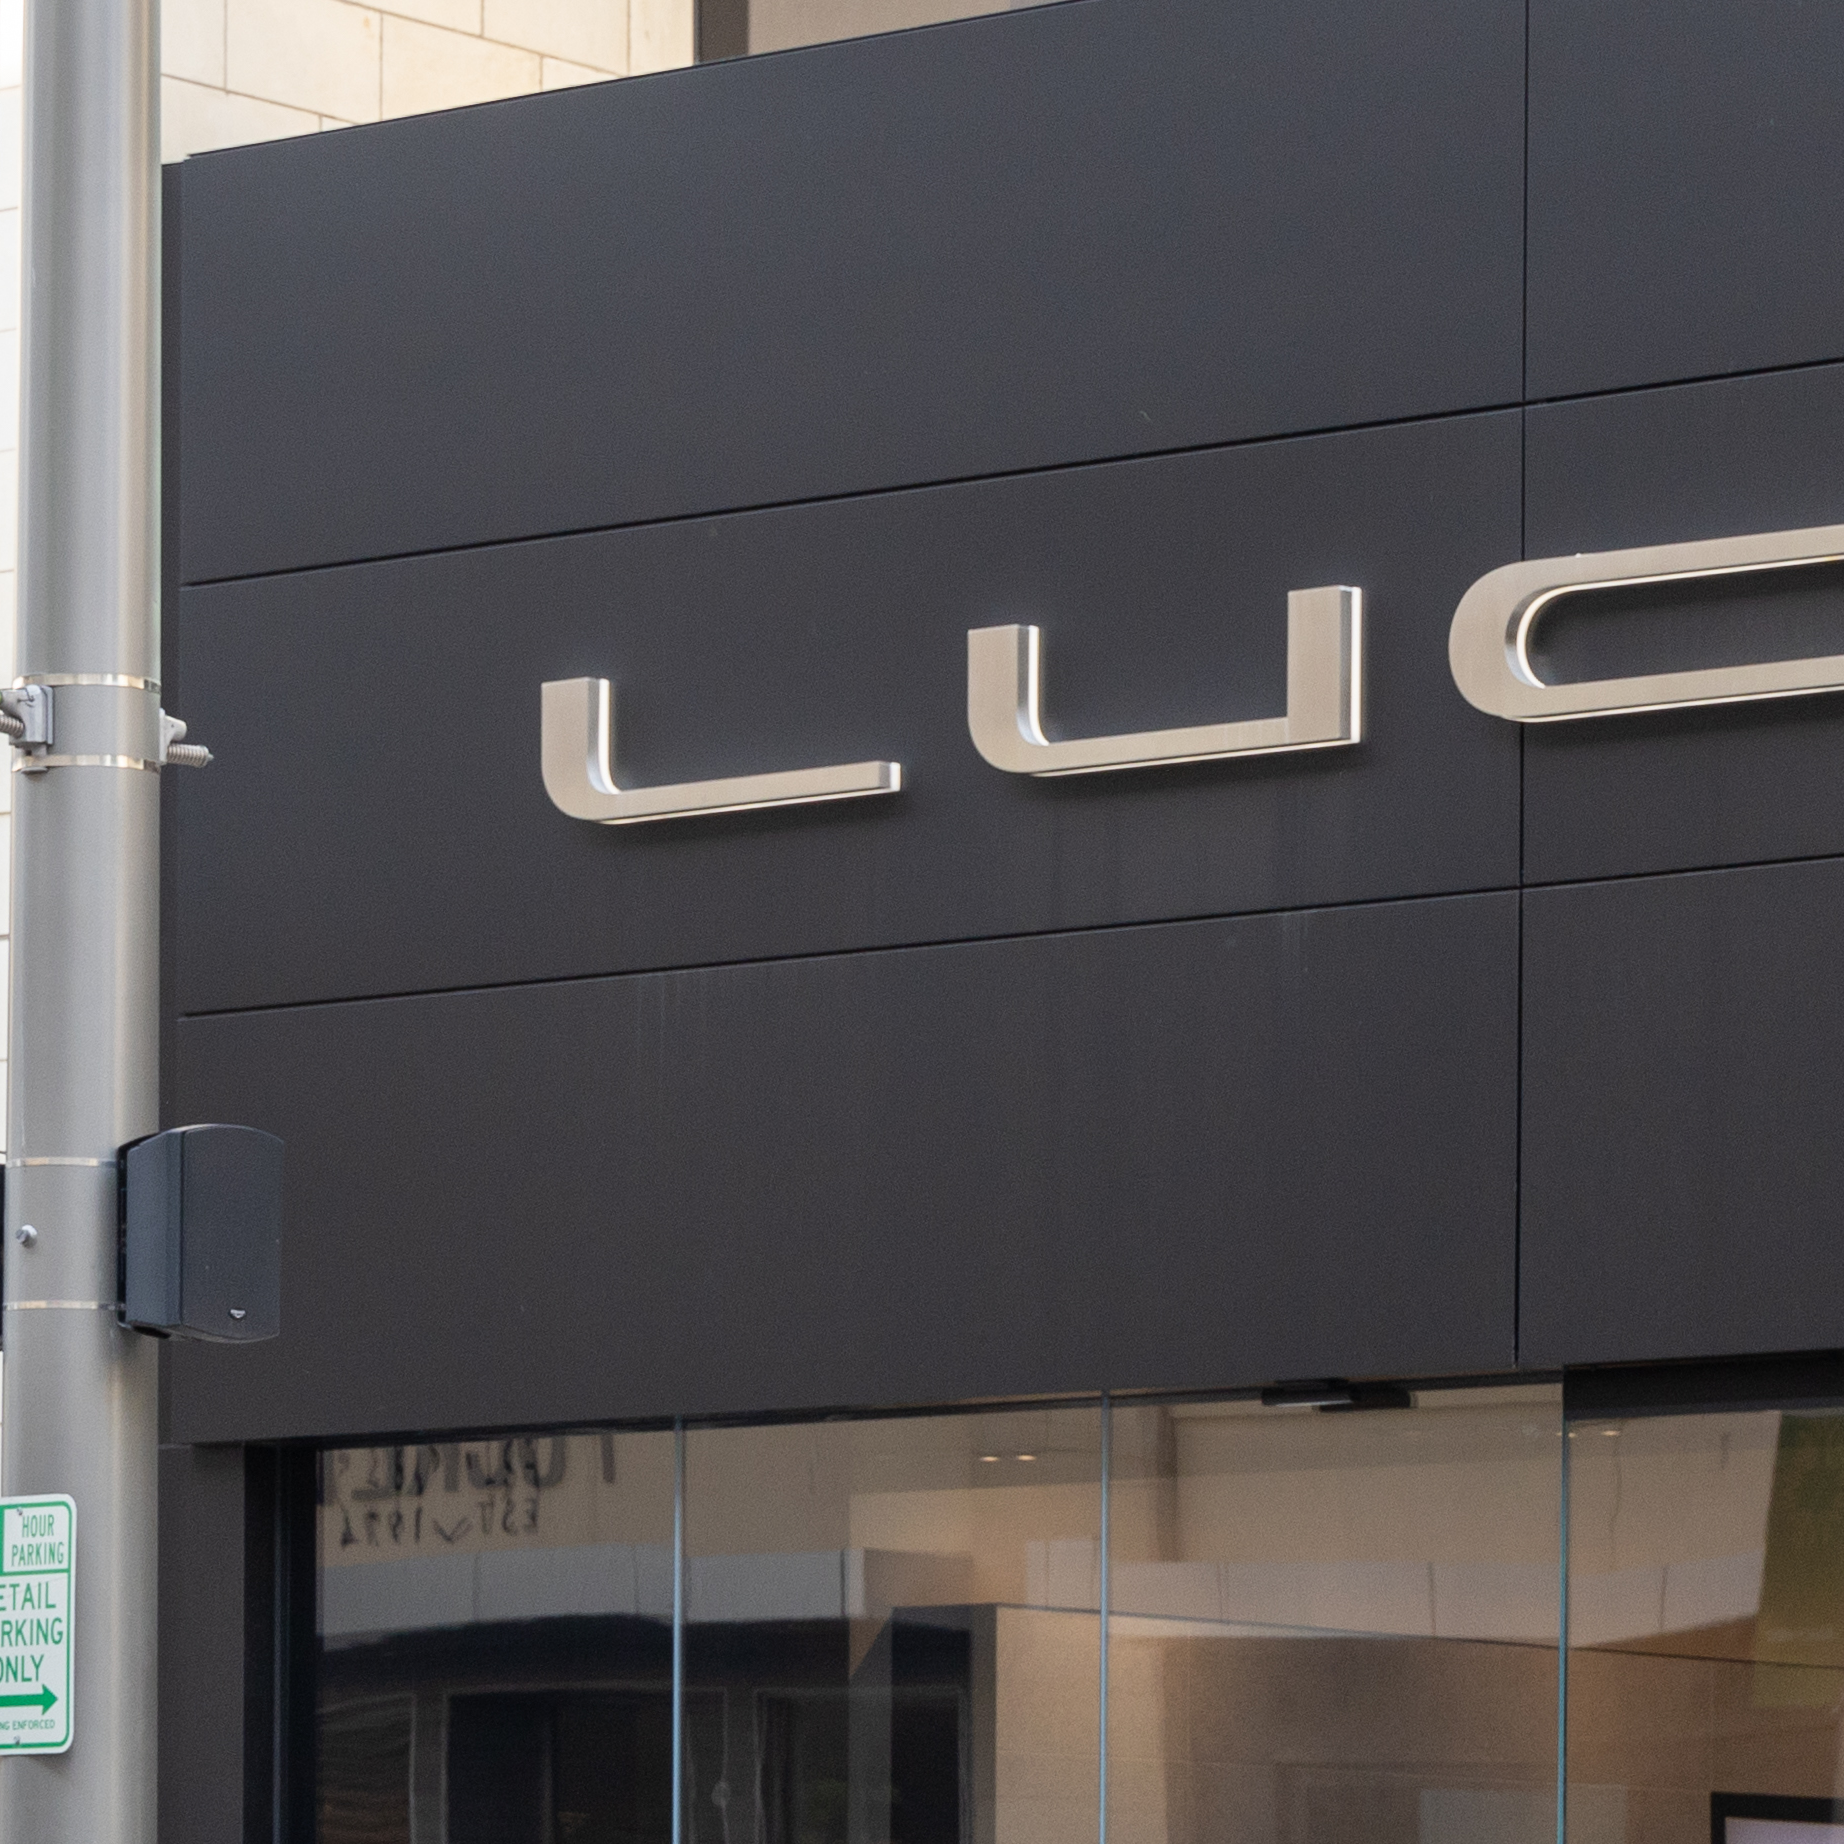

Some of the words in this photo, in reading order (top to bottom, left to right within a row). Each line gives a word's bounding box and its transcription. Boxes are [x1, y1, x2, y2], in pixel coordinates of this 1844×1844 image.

[21, 1513, 56, 1539] HOUR
[10, 1541, 65, 1567] PARKING
[12, 1719, 56, 1731] ENFORCED
